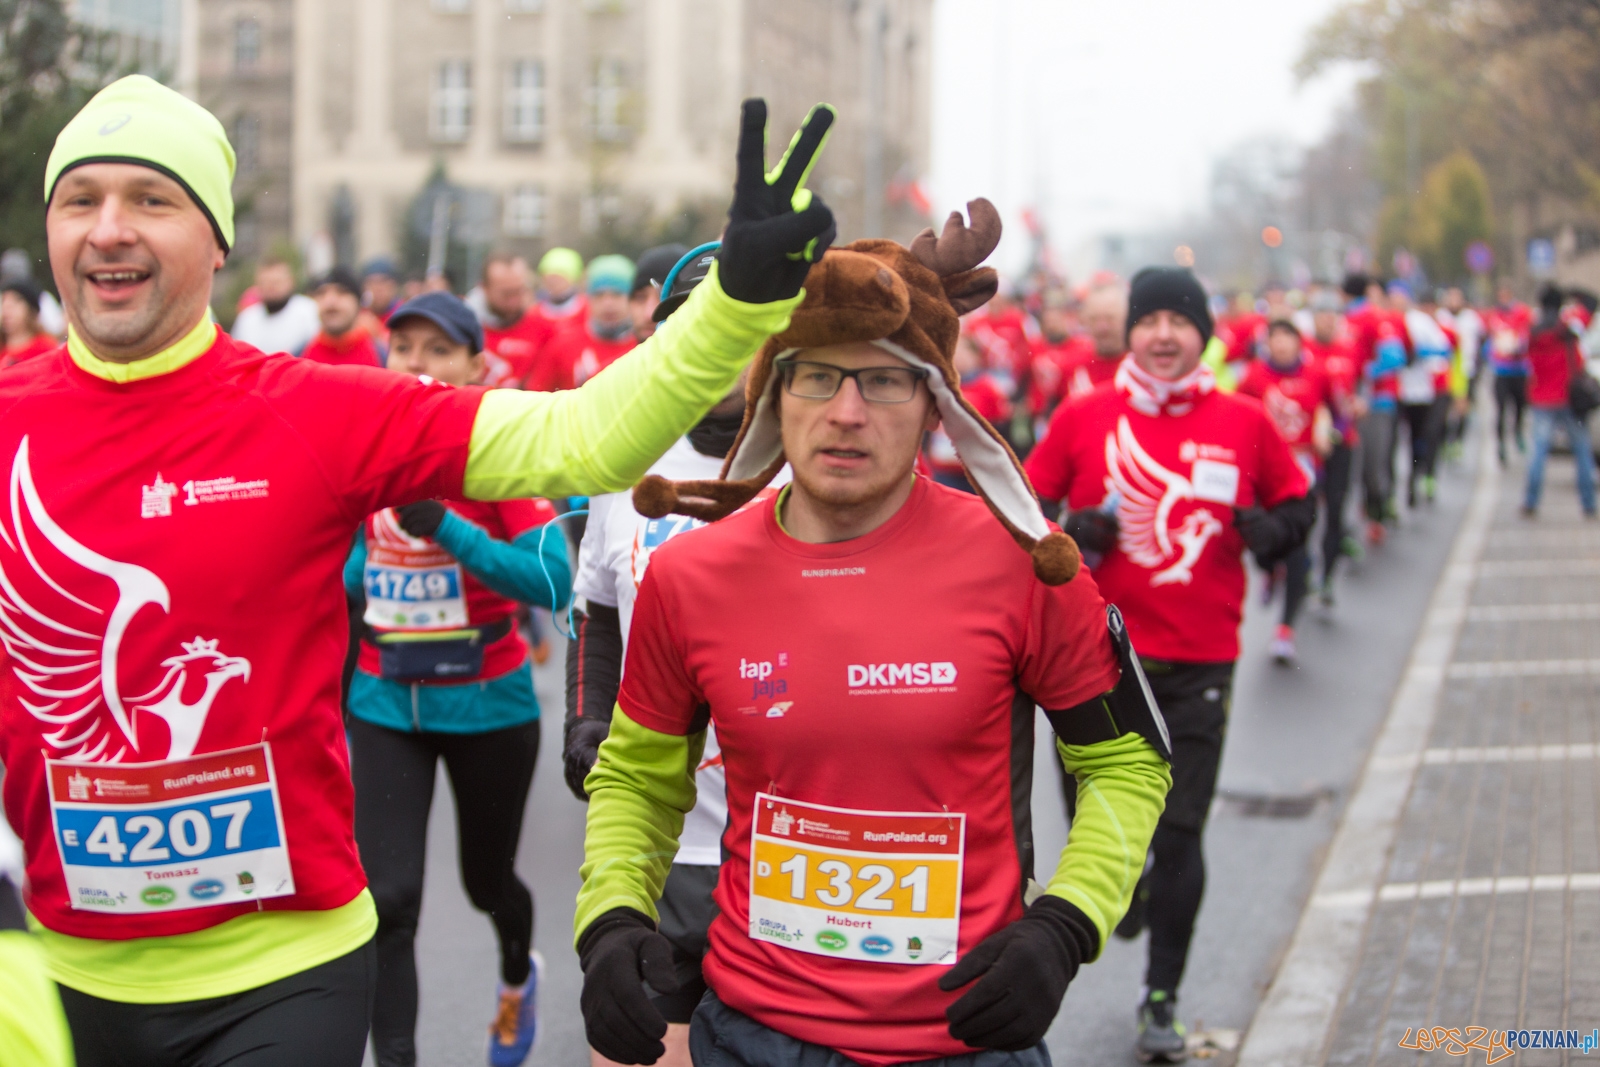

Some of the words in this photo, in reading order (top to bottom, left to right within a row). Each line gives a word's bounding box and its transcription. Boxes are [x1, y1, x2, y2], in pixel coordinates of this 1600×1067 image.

[375, 571, 448, 599] 1749
[847, 662, 931, 687] DKMS
[163, 765, 256, 790] RunPoland.org
[62, 830, 79, 847] E
[85, 799, 252, 863] 4207
[863, 831, 948, 845] RunPoland.org
[145, 867, 199, 881] Tomasz
[757, 861, 771, 877] D
[780, 853, 929, 912] 1321
[826, 915, 873, 929] Hubert
